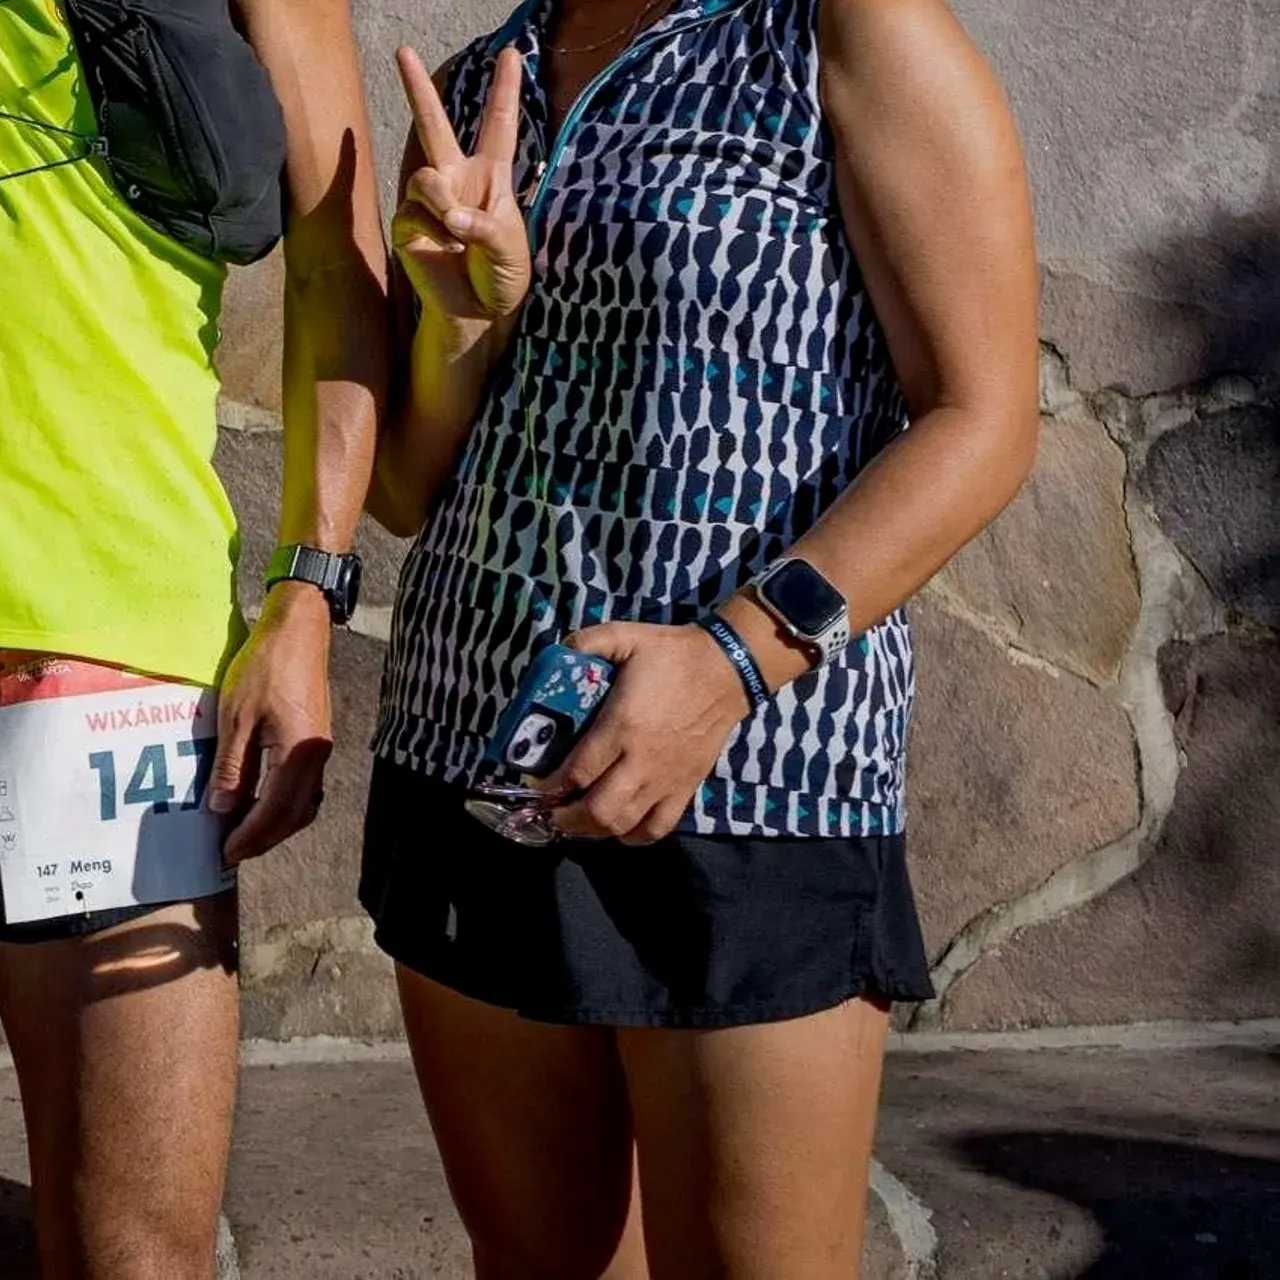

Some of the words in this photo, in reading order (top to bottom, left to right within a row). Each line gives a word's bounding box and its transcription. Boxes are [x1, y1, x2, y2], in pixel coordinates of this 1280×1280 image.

[710, 622, 762, 694] SUPPORTING
[85, 700, 203, 732] WIXÁRIKA
[88, 735, 218, 821] 147
[37, 863, 58, 878] 147
[70, 859, 113, 874] Meng
